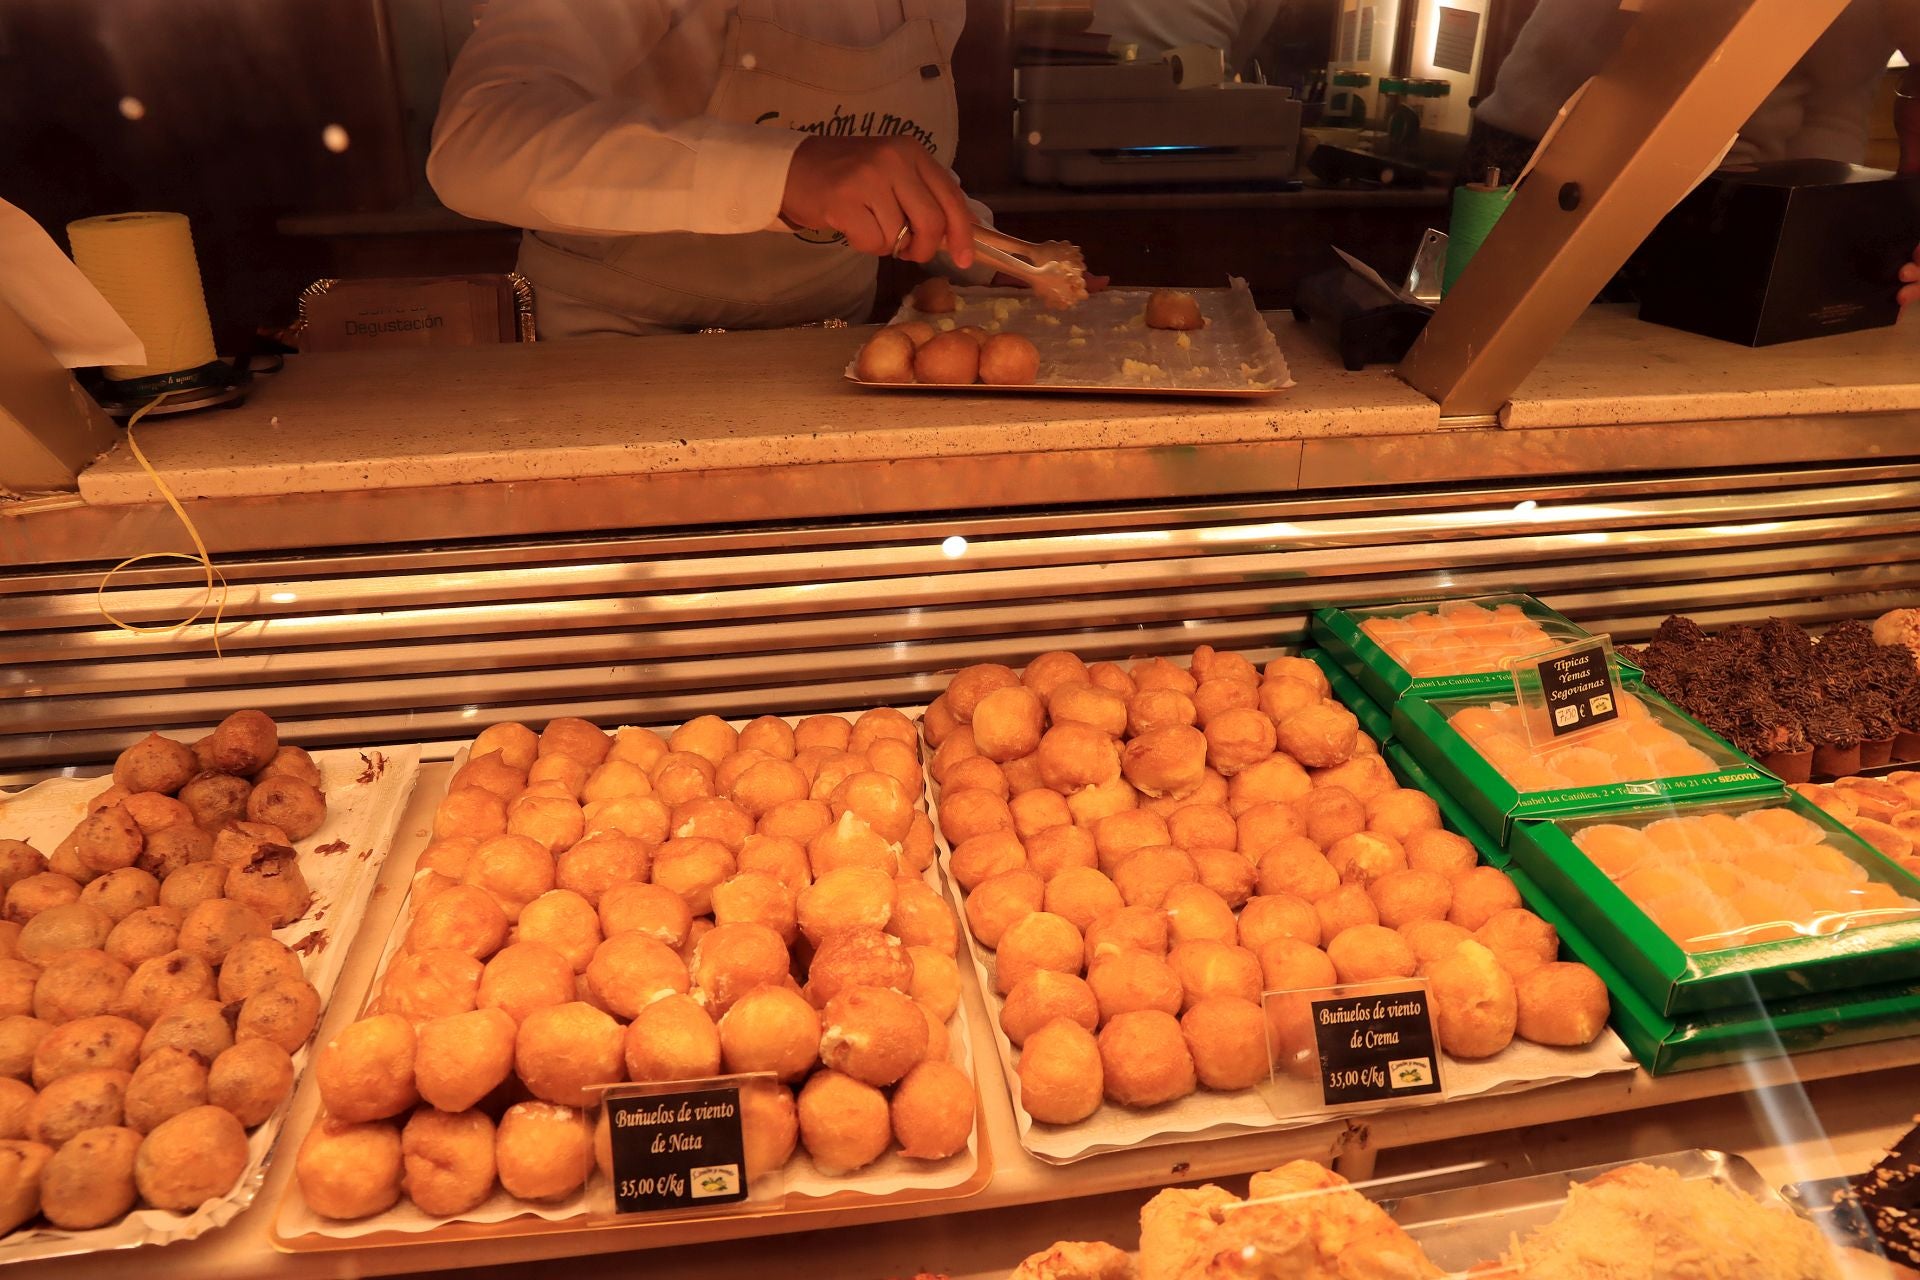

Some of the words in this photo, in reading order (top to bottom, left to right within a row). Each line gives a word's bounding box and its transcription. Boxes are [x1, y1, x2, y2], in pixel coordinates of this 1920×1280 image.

[345, 313, 443, 337] Degustación
[1558, 669, 1591, 684] Yemas
[1550, 678, 1605, 701] Segovianas
[1579, 703, 1586, 718] €
[1518, 797, 1546, 807] Isabel
[1547, 796, 1560, 804] La
[1601, 789, 1609, 797] 2
[1689, 779, 1700, 787] 21
[1717, 772, 1761, 784] SEGOVIA
[1320, 1003, 1371, 1025] Buñuelos
[1373, 1001, 1385, 1020] de
[1387, 1001, 1421, 1017] viento
[1350, 1030, 1363, 1048] de
[1365, 1030, 1400, 1049] Crema
[1329, 1070, 1359, 1089] 35,00
[1361, 1066, 1385, 1088] €/kg
[615, 1104, 675, 1128] Buñuelos
[677, 1102, 692, 1122] de
[694, 1101, 734, 1120] viento
[651, 1133, 666, 1153] de
[668, 1133, 703, 1153] Nata
[620, 1178, 654, 1198] 35,00
[657, 1173, 684, 1197] €/kg
